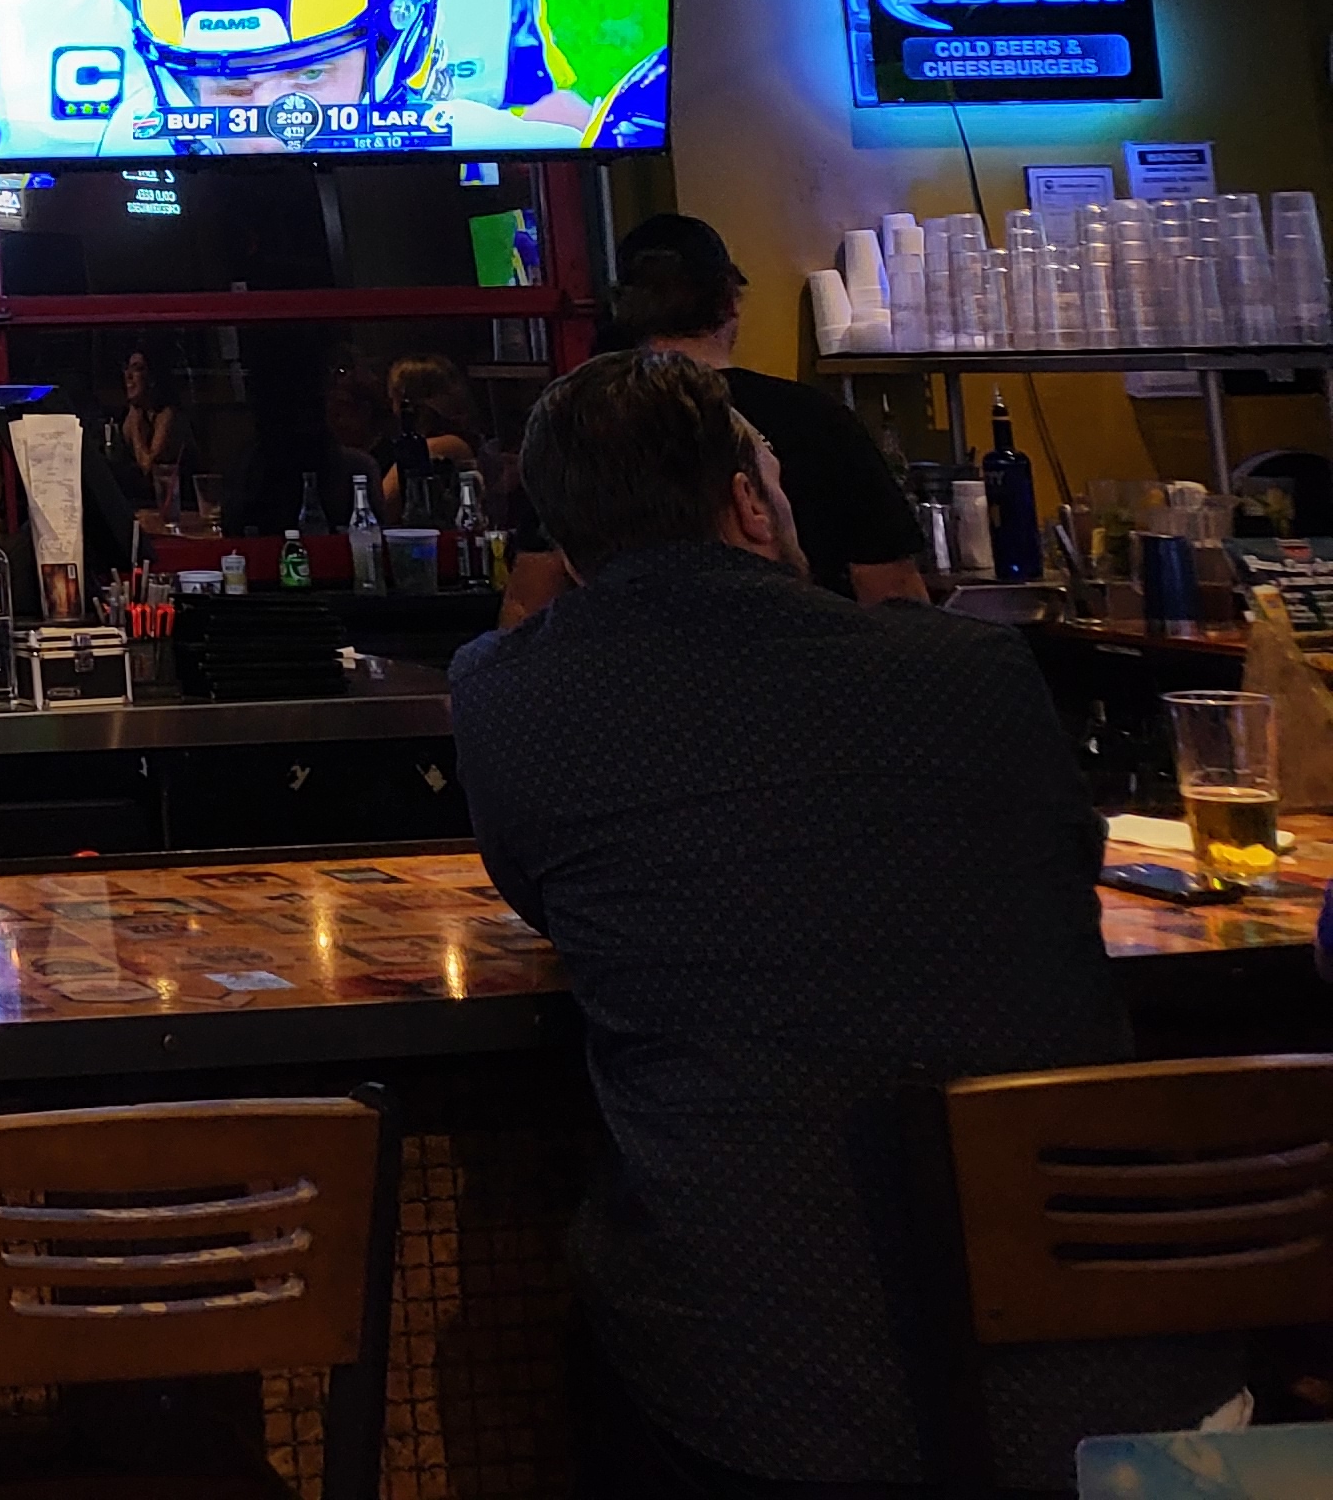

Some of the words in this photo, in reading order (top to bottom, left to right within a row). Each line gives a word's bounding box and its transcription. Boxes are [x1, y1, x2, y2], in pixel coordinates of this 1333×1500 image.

[200, 17, 261, 31] RAMS
[935, 41, 990, 58] COLD
[994, 40, 1062, 57] BEERS
[1067, 39, 1083, 55] &
[923, 58, 1099, 77] CHEESEBURGERS
[167, 113, 214, 130] BUF
[228, 108, 258, 132] 31
[276, 112, 313, 125] 2:00
[327, 106, 359, 130] 10
[372, 113, 419, 127] LAR
[353, 136, 371, 148] 1st
[372, 137, 384, 148] &
[386, 137, 402, 148] 10
